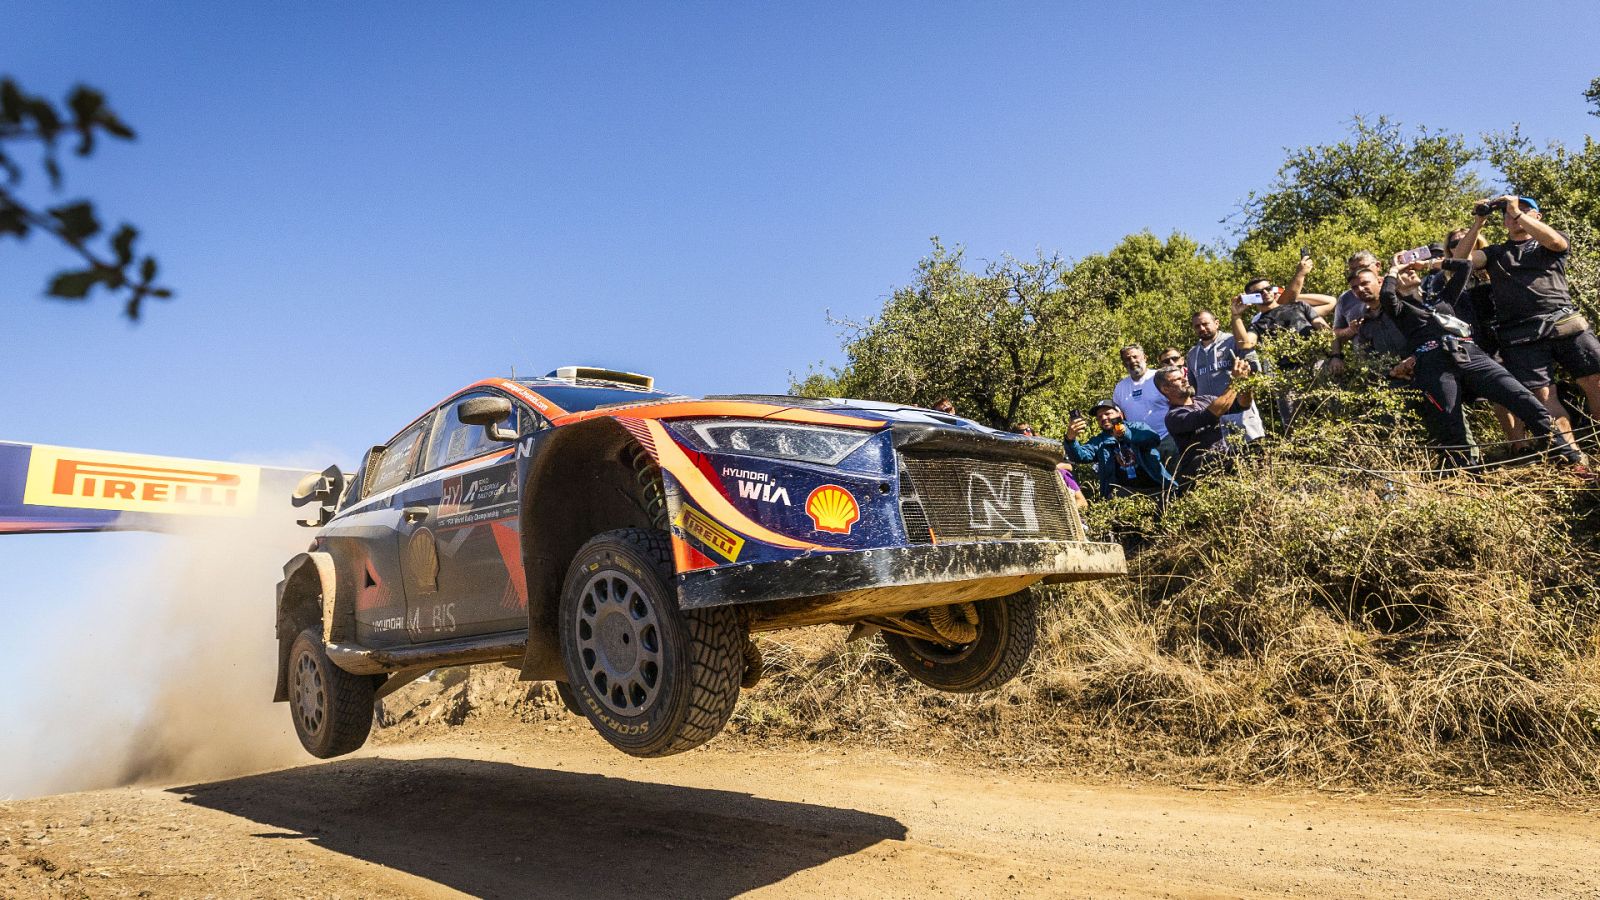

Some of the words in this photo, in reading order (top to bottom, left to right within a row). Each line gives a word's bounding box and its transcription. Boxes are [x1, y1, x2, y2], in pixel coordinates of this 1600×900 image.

[1199, 360, 1232, 375] BULDOG
[516, 437, 536, 460] N
[51, 458, 241, 507] PIRELLI
[722, 467, 768, 482] HYUNDAI
[738, 478, 791, 506] WIA
[967, 470, 1039, 531] N
[682, 509, 737, 554] PIRELLI
